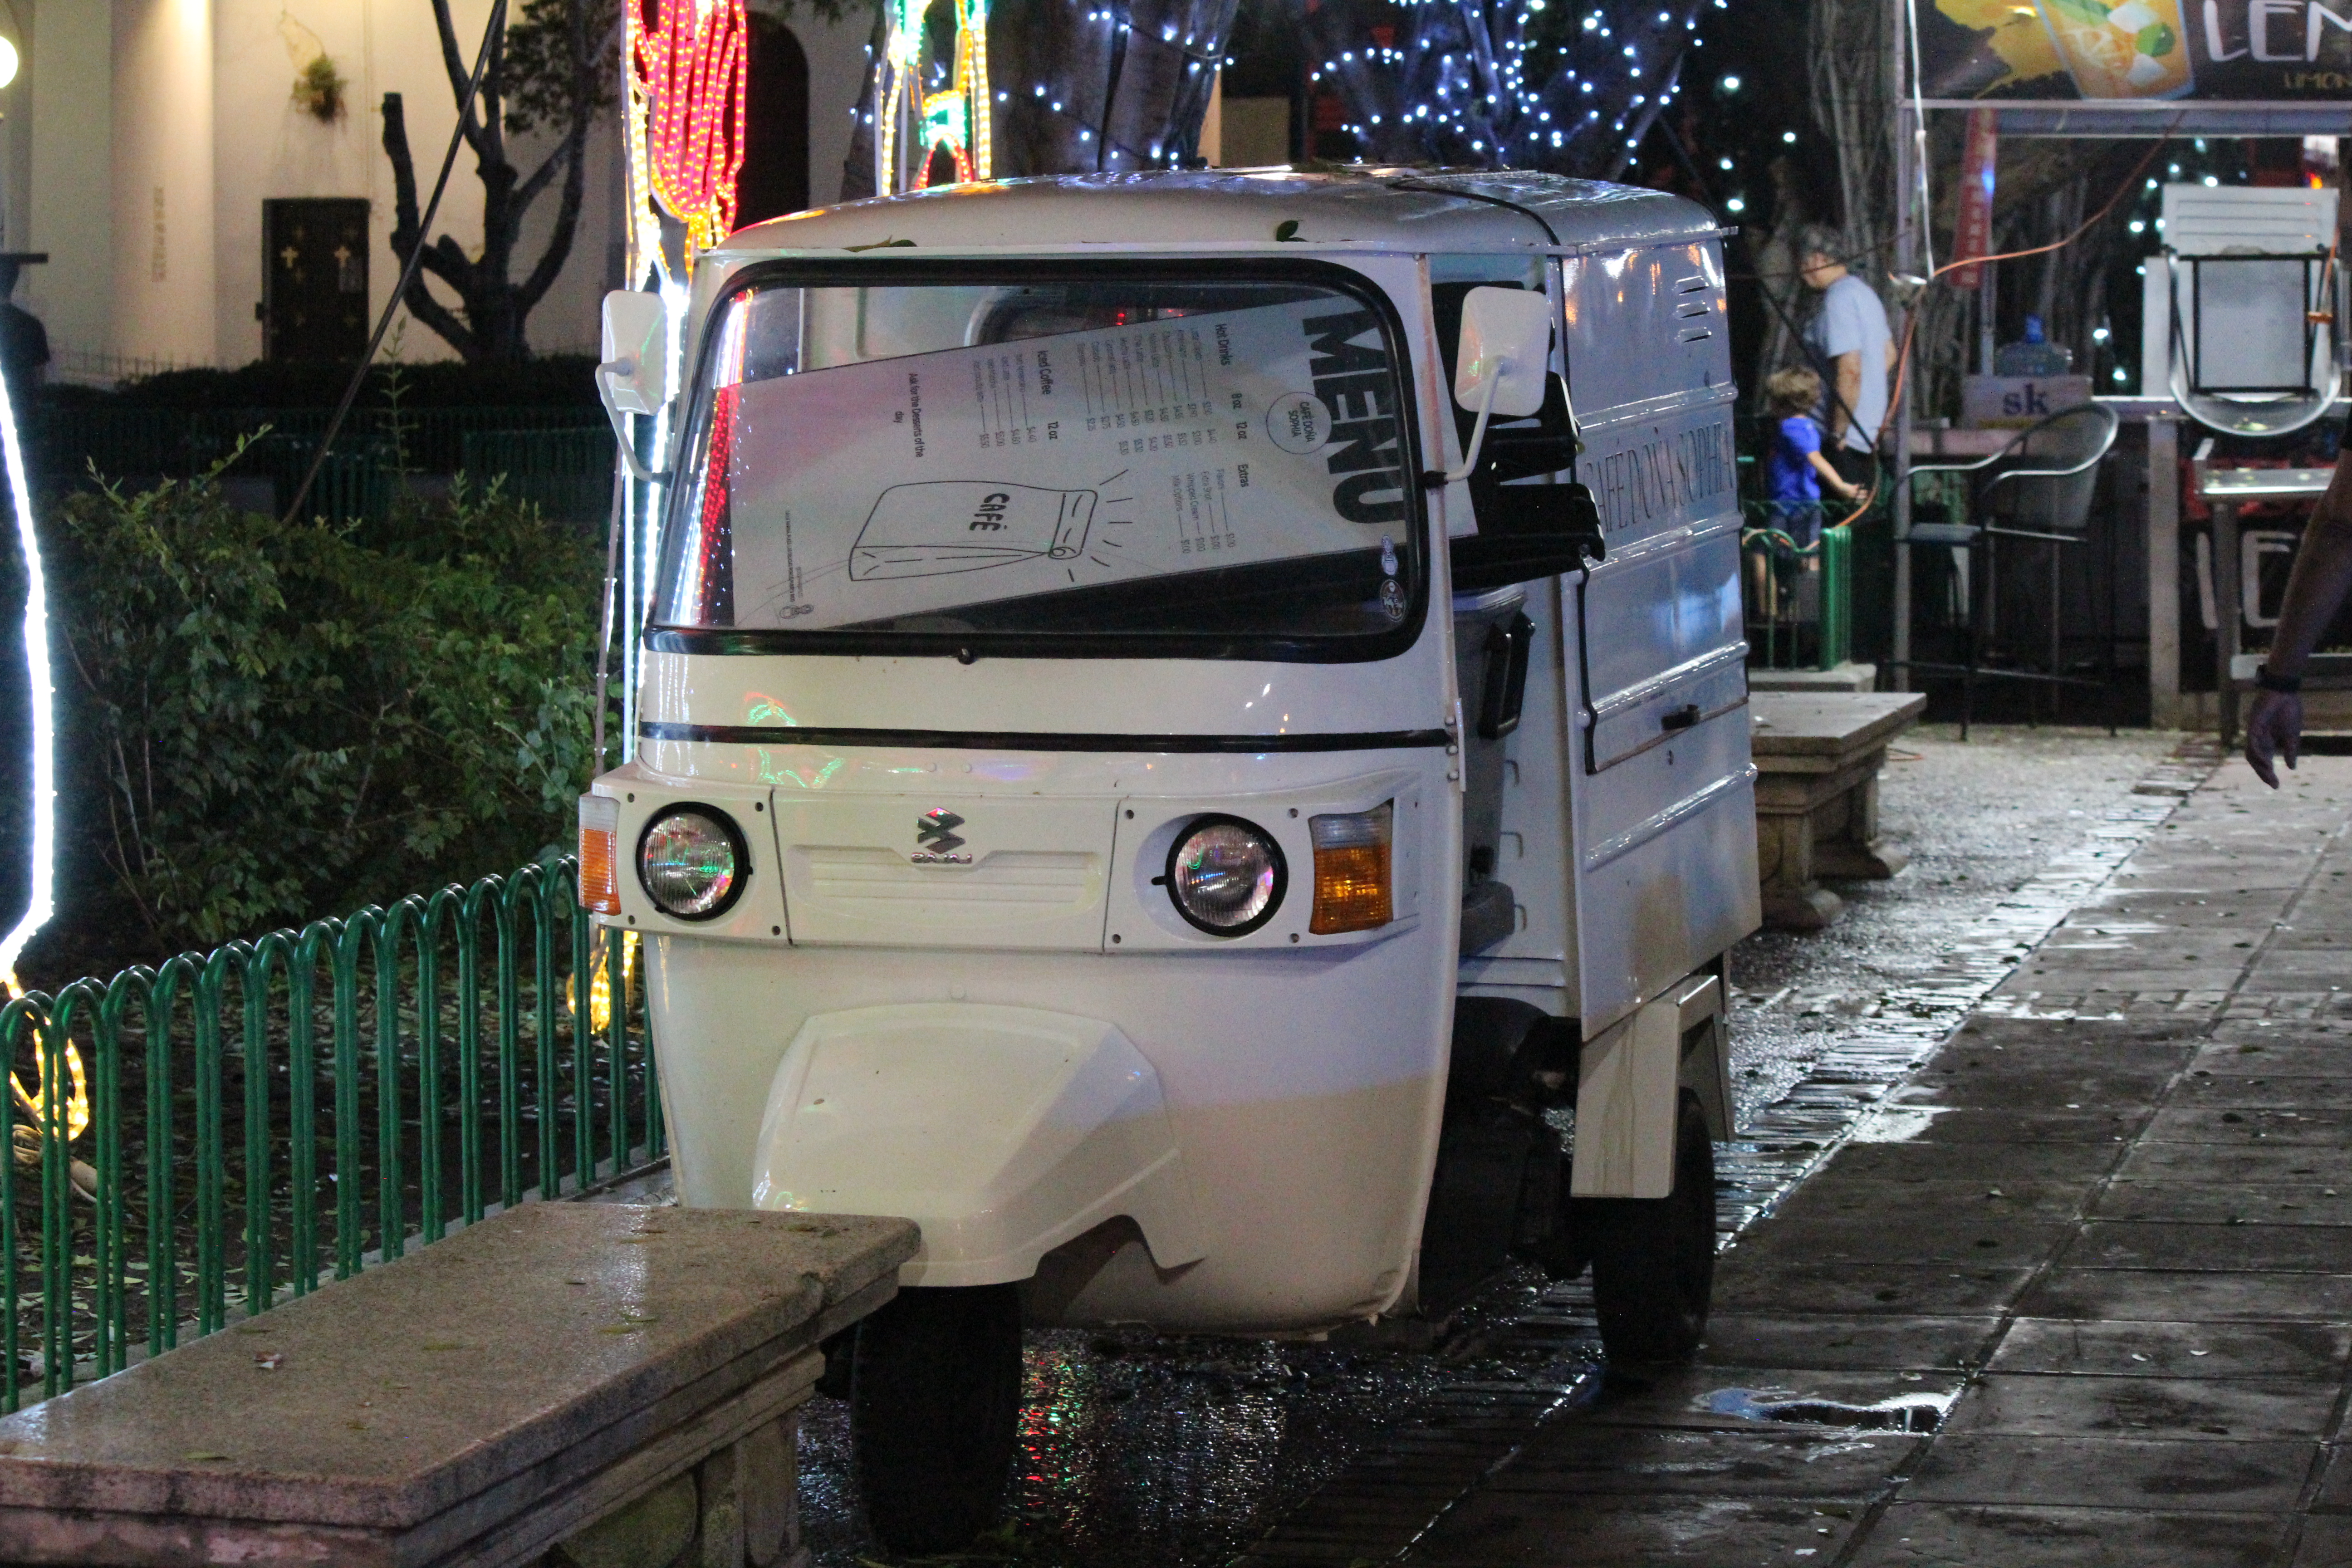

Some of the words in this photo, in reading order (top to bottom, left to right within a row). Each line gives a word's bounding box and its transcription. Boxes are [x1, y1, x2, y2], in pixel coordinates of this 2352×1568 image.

[1215, 323, 1227, 338] Hot
[1037, 350, 1050, 368] Iced
[1218, 339, 1232, 365] Drinks
[909, 373, 918, 385] Ask
[1039, 368, 1053, 394] Coffee
[910, 385, 920, 395] for
[911, 396, 920, 407] the
[1232, 398, 1241, 409] oz
[893, 411, 904, 423] day
[1299, 402, 1313, 419] CAFÉ
[1303, 309, 1406, 523] MENU
[912, 408, 921, 436] Desserts
[1048, 421, 1058, 429] 12
[1236, 421, 1247, 429] 12
[1288, 410, 1301, 437] SOPHIA
[1049, 431, 1057, 440] oz
[1237, 430, 1247, 439] oz
[1303, 421, 1314, 442] DOÑA
[915, 445, 925, 457] the
[1238, 464, 1248, 487] Extras
[1186, 473, 1196, 500] Whipped
[970, 493, 1009, 530] CAFÉ
[1190, 501, 1199, 520] Cream
[911, 852, 972, 864] BAJAJ
